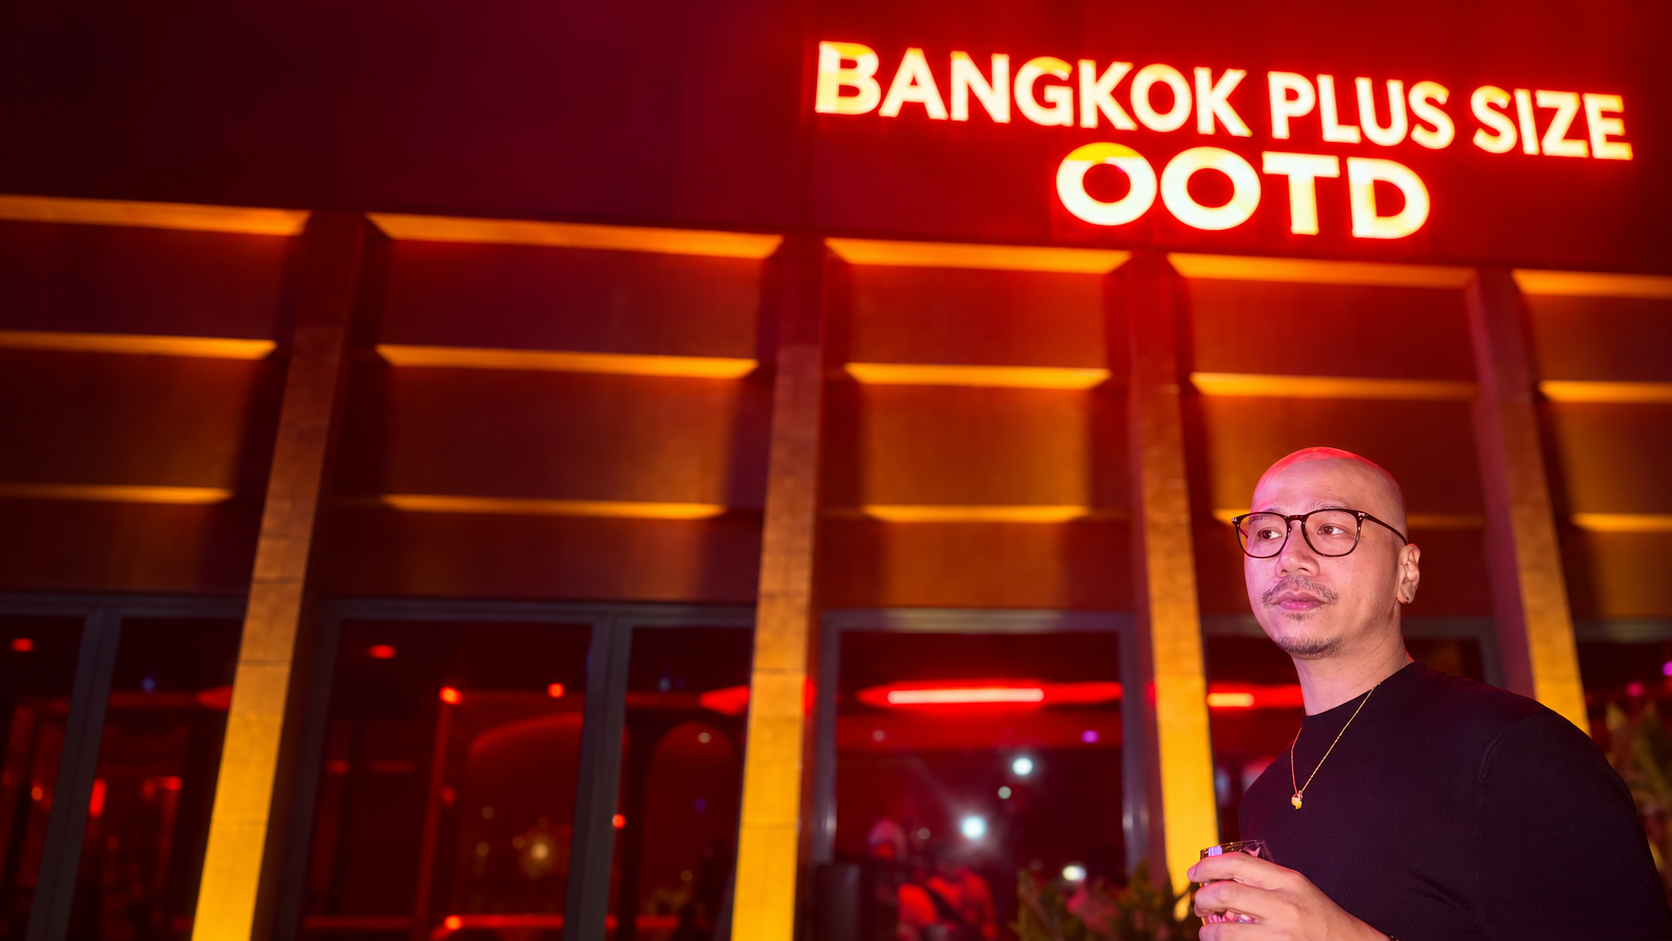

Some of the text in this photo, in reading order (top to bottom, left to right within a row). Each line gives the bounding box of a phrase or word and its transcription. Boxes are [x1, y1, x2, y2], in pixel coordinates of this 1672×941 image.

[815, 40, 1633, 161] BANGKOK PLUS SIZE
[1055, 142, 1430, 239] OOTD
